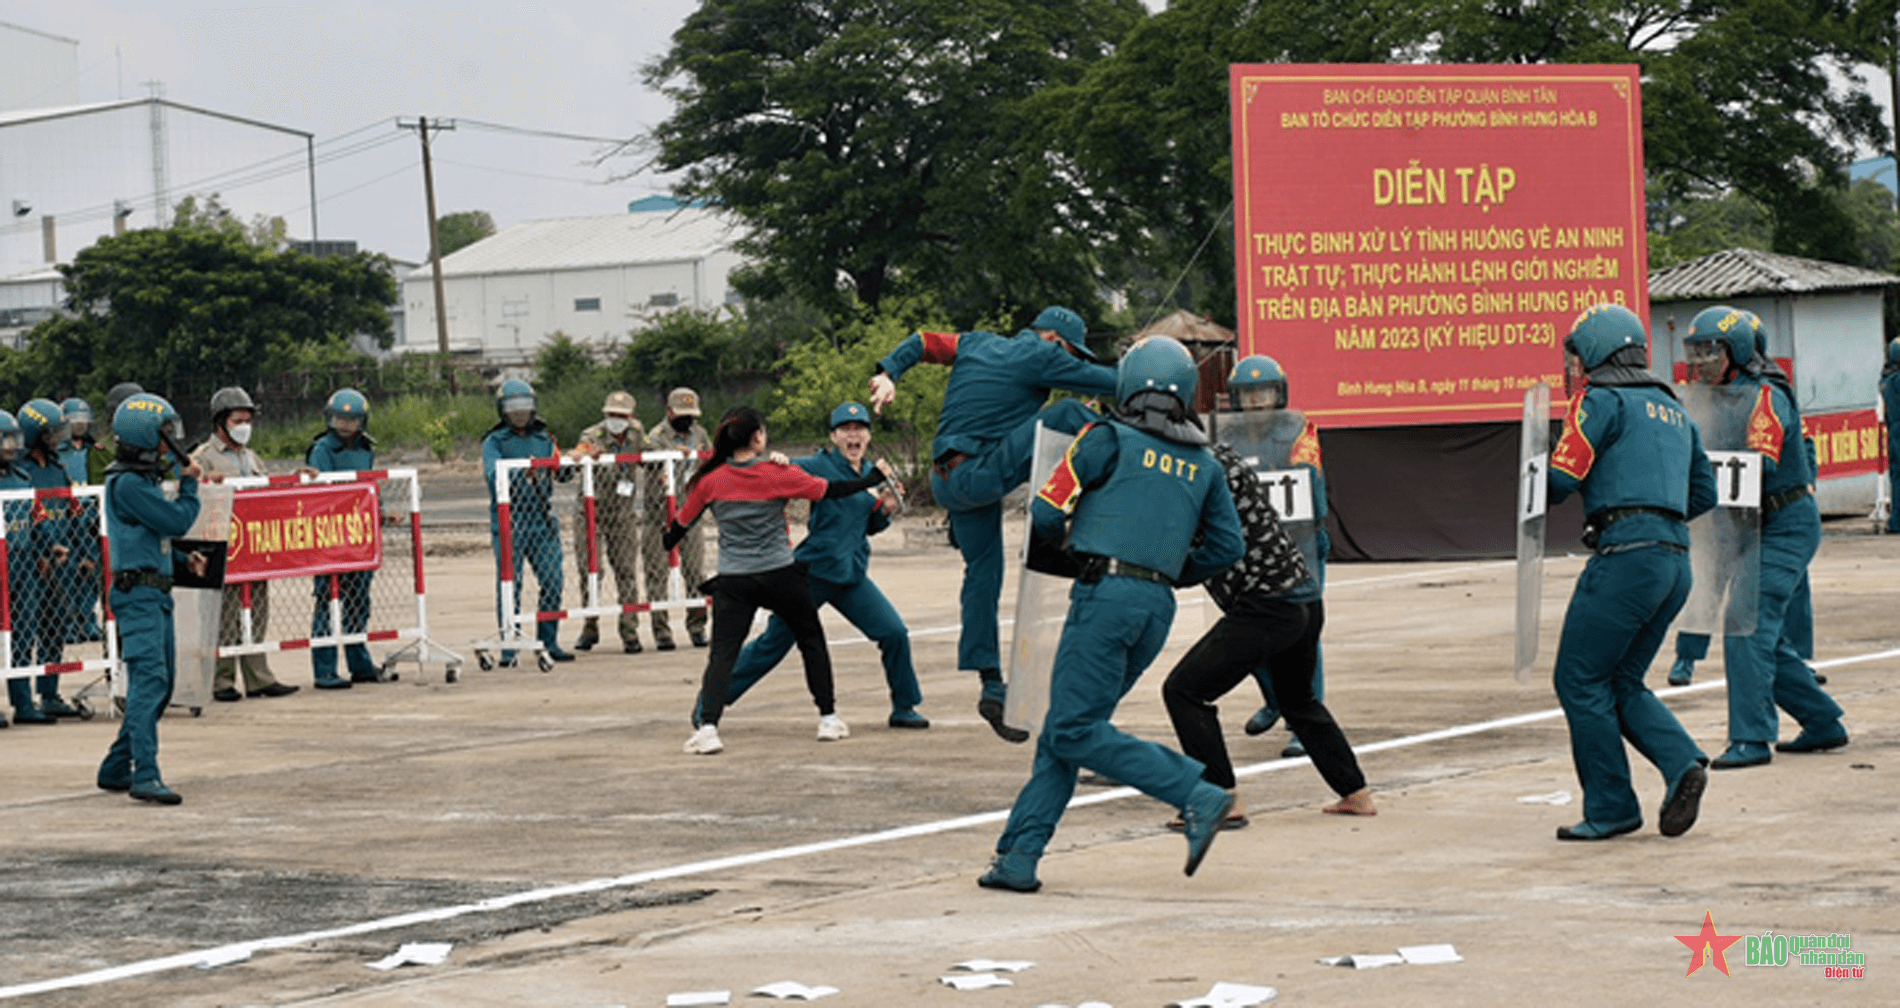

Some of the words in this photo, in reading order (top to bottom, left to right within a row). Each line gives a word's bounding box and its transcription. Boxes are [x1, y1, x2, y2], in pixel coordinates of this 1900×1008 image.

[1323, 89, 1349, 104] BAN
[1281, 112, 1309, 128] BAN
[1405, 111, 1430, 130] TẬP
[1522, 110, 1558, 127] HƯNG
[1560, 109, 1587, 126] HÒA
[1588, 110, 1598, 127] B
[1373, 159, 1447, 205] DIỄN
[1454, 162, 1516, 213] TẬP
[1253, 232, 1306, 260] THỰC
[1310, 231, 1355, 254] BINH
[1358, 226, 1386, 253] XỬ
[1389, 226, 1413, 252] LÝ
[1417, 226, 1457, 251] TÌNH
[1461, 224, 1525, 251] HUỐNG
[1555, 227, 1579, 249] AN
[1583, 226, 1624, 248] NINH
[1261, 263, 1310, 292] TRẬT
[1351, 263, 1401, 290] THỰC
[1405, 256, 1457, 284] HÀNH
[1461, 258, 1507, 287] LỆNH
[1511, 254, 1549, 282] GIỚI
[1256, 293, 1305, 320] TRÊN
[1310, 296, 1342, 323] ĐỊA
[1388, 289, 1467, 317] PHƯỜNG
[1472, 287, 1514, 315] BÌNH
[1518, 289, 1569, 313] HƯNG
[1335, 324, 1376, 350] NĂM
[1380, 326, 1420, 350] 2023
[1423, 320, 1454, 353] (KÝ
[1458, 322, 1499, 351] HIỆU
[1504, 321, 1556, 349] DT-23)
[1144, 449, 1198, 482] DQTT
[246, 519, 283, 562] TRẠM
[283, 500, 315, 551] KIỂM
[345, 498, 363, 545] SỐ
[364, 511, 373, 545] 3
